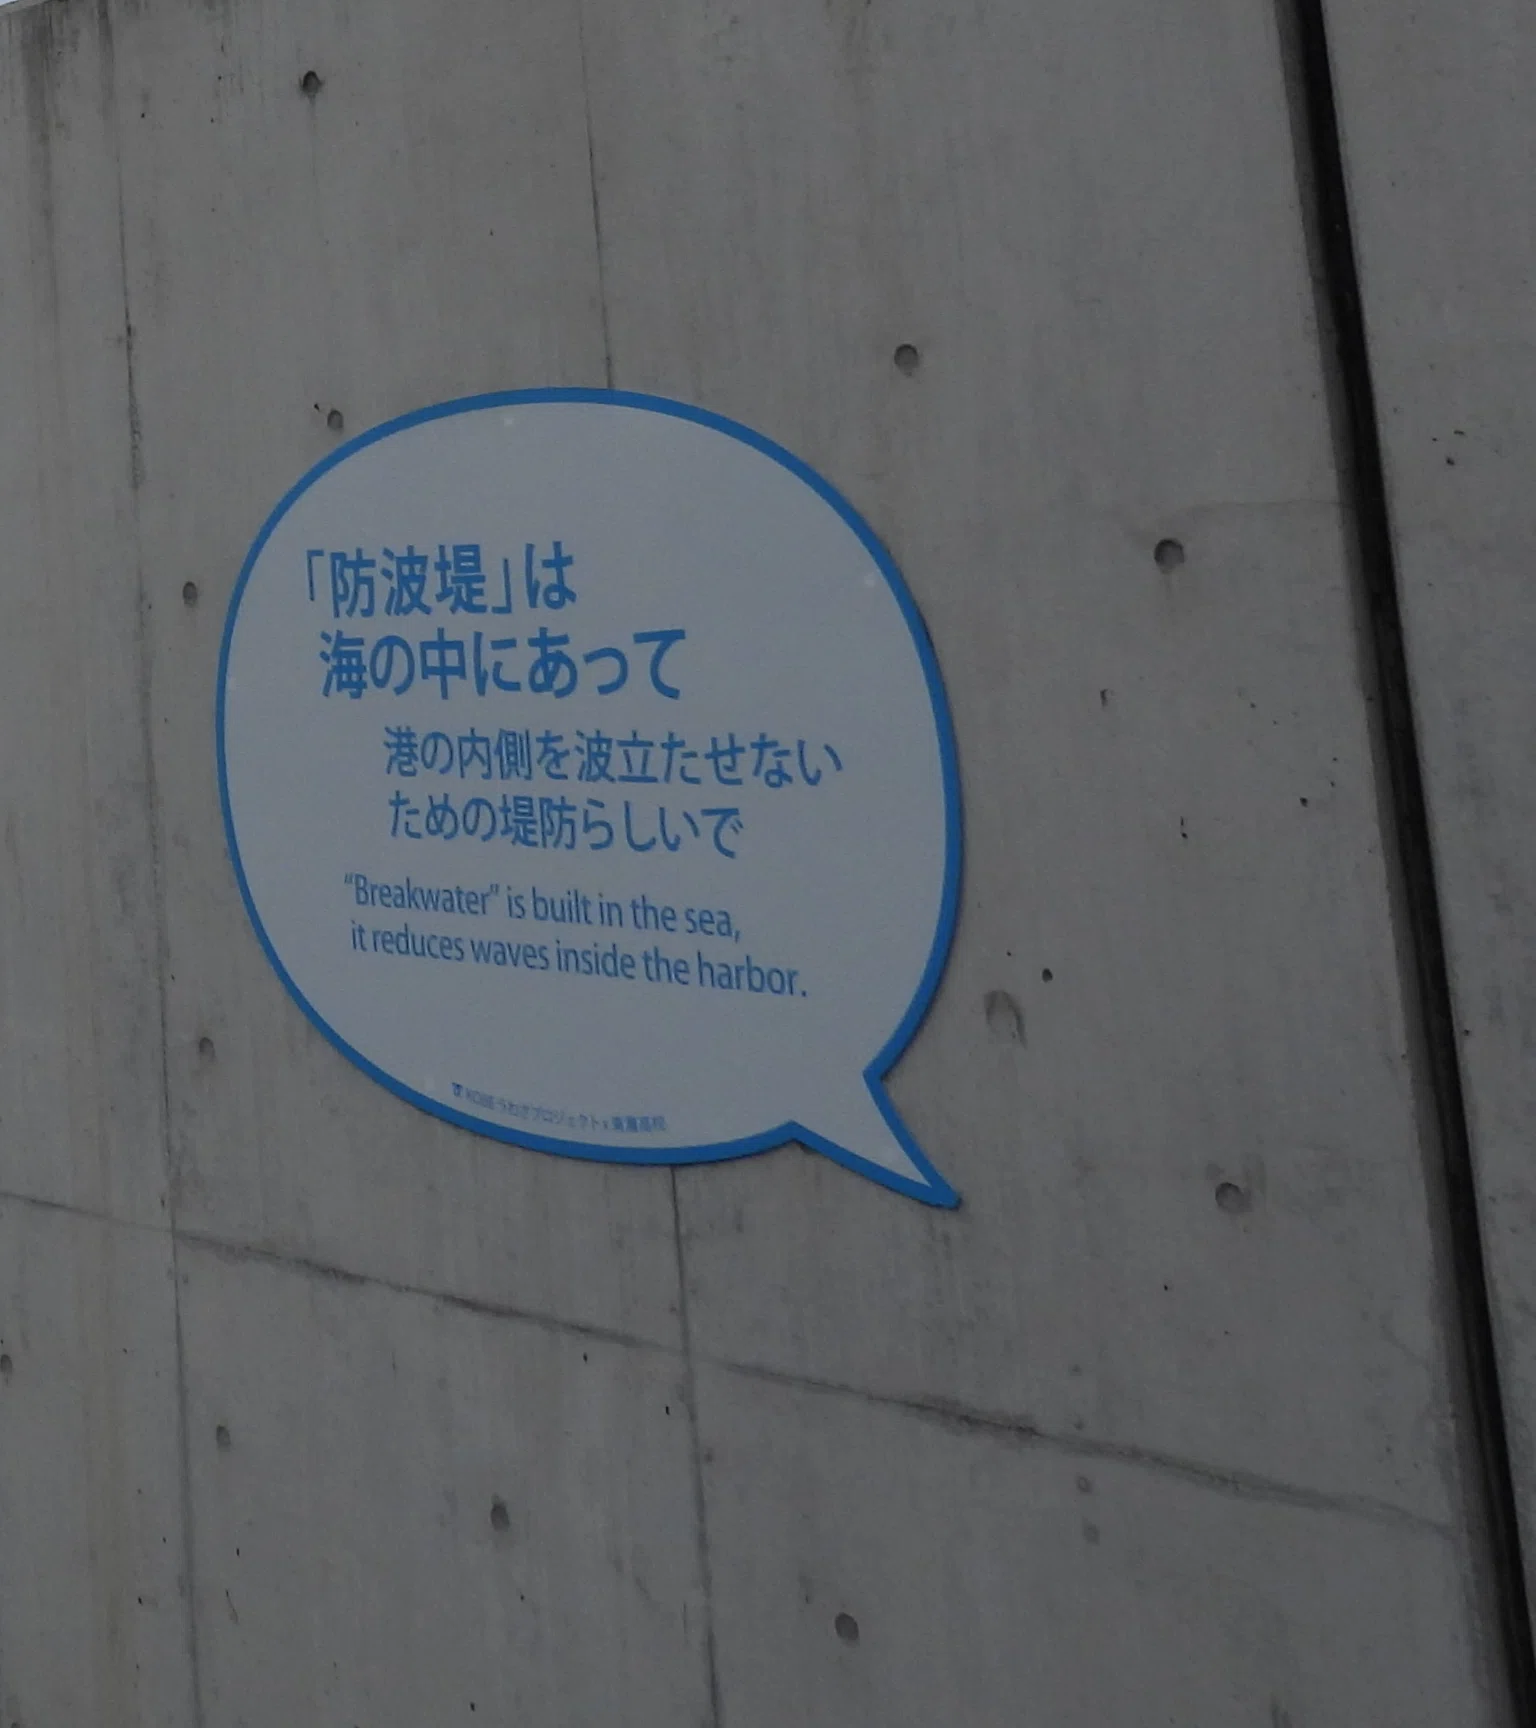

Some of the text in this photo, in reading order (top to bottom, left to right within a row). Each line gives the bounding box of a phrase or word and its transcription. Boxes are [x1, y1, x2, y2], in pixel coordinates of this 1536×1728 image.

[306, 541, 577, 619] 「防波堤」は
[319, 627, 686, 700] 海の中にあって
[383, 725, 844, 789] 港の内側を波立たせない
[388, 790, 744, 859] ための堤防らしいで
[506, 885, 527, 920] is
[532, 887, 593, 927] built
[598, 892, 623, 928] in
[630, 895, 677, 934] the
[685, 906, 741, 944] sea,
[350, 920, 808, 998] it reduces waves inside the harbor.
